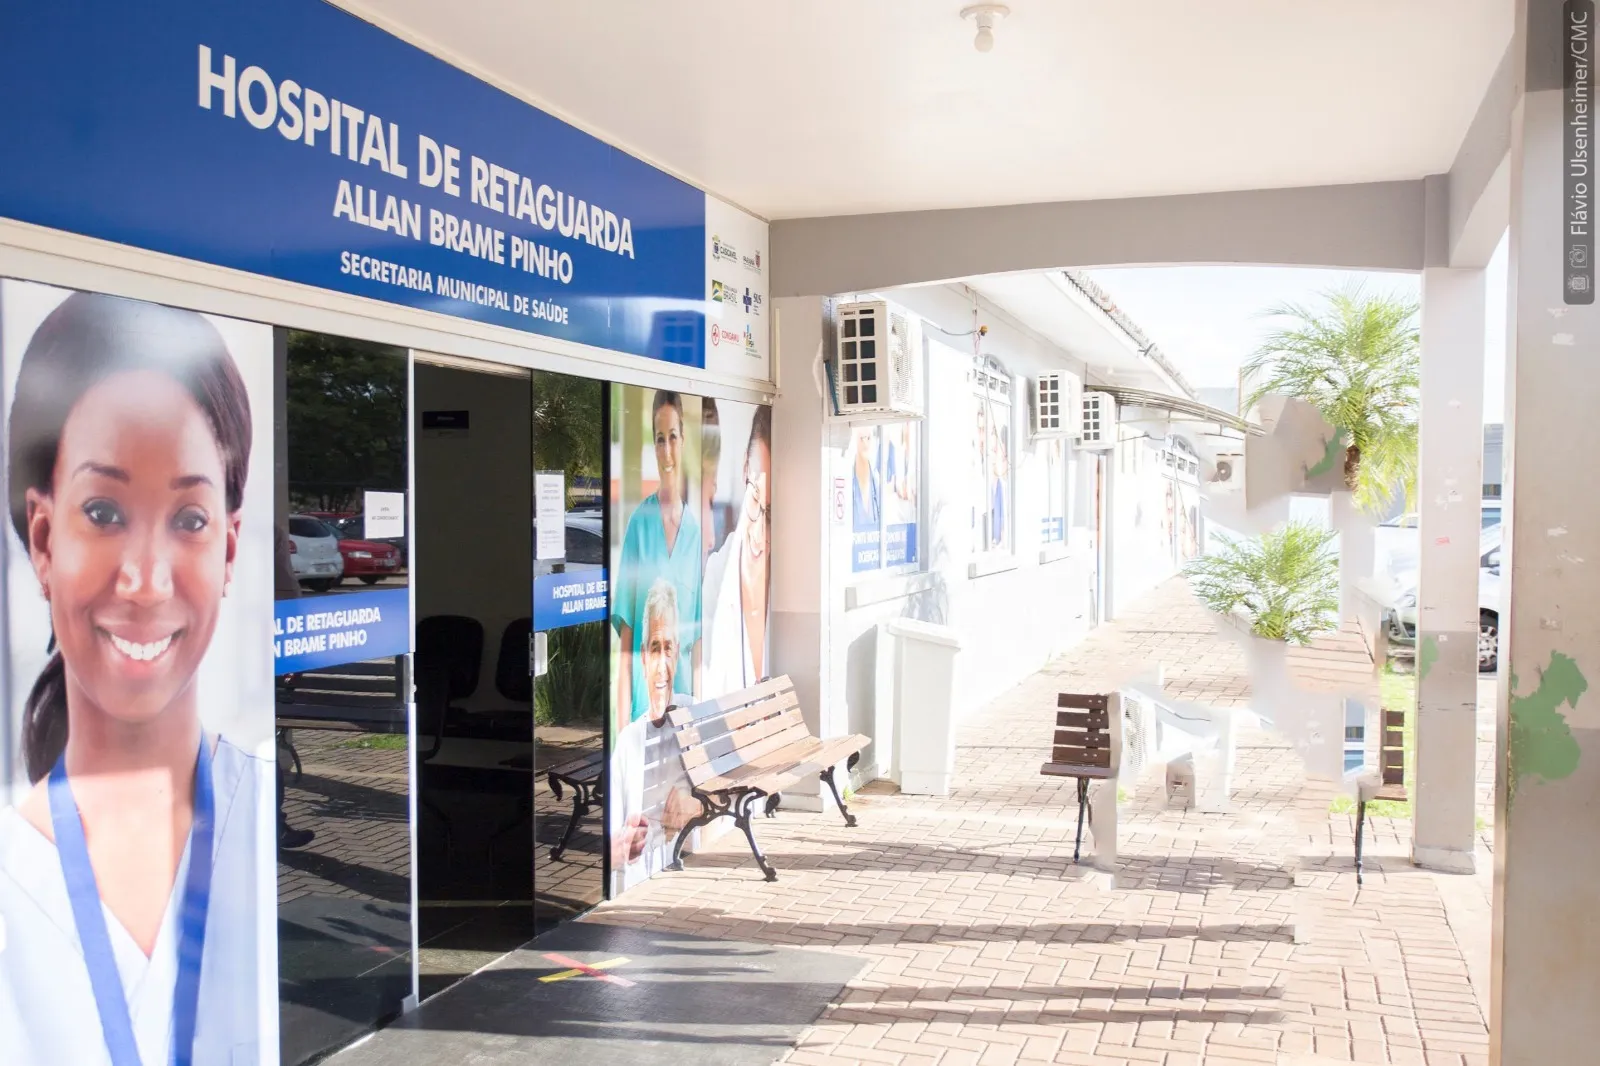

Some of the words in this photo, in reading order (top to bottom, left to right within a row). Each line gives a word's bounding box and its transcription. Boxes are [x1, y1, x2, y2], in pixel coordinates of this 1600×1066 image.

[198, 44, 408, 179] HOSPITAL
[418, 134, 460, 197] DE
[471, 155, 635, 260] RETAGUARDA
[333, 179, 421, 241] ALLAN
[430, 208, 505, 265] BRAME
[511, 235, 573, 285] PINHO
[340, 250, 434, 294] SECRETARIA
[436, 275, 511, 312] MUNICIPAL
[513, 294, 529, 316] DE
[532, 298, 569, 325] SAÚDE
[553, 583, 585, 600] HOSPITAL
[586, 582, 595, 595] DE
[561, 599, 584, 615] ALLAN
[585, 596, 607, 611] BRAME
[286, 615, 304, 634] DE
[306, 606, 381, 632] RETAGUARDA
[284, 634, 327, 657] BRAME
[328, 629, 368, 650] PINHO
